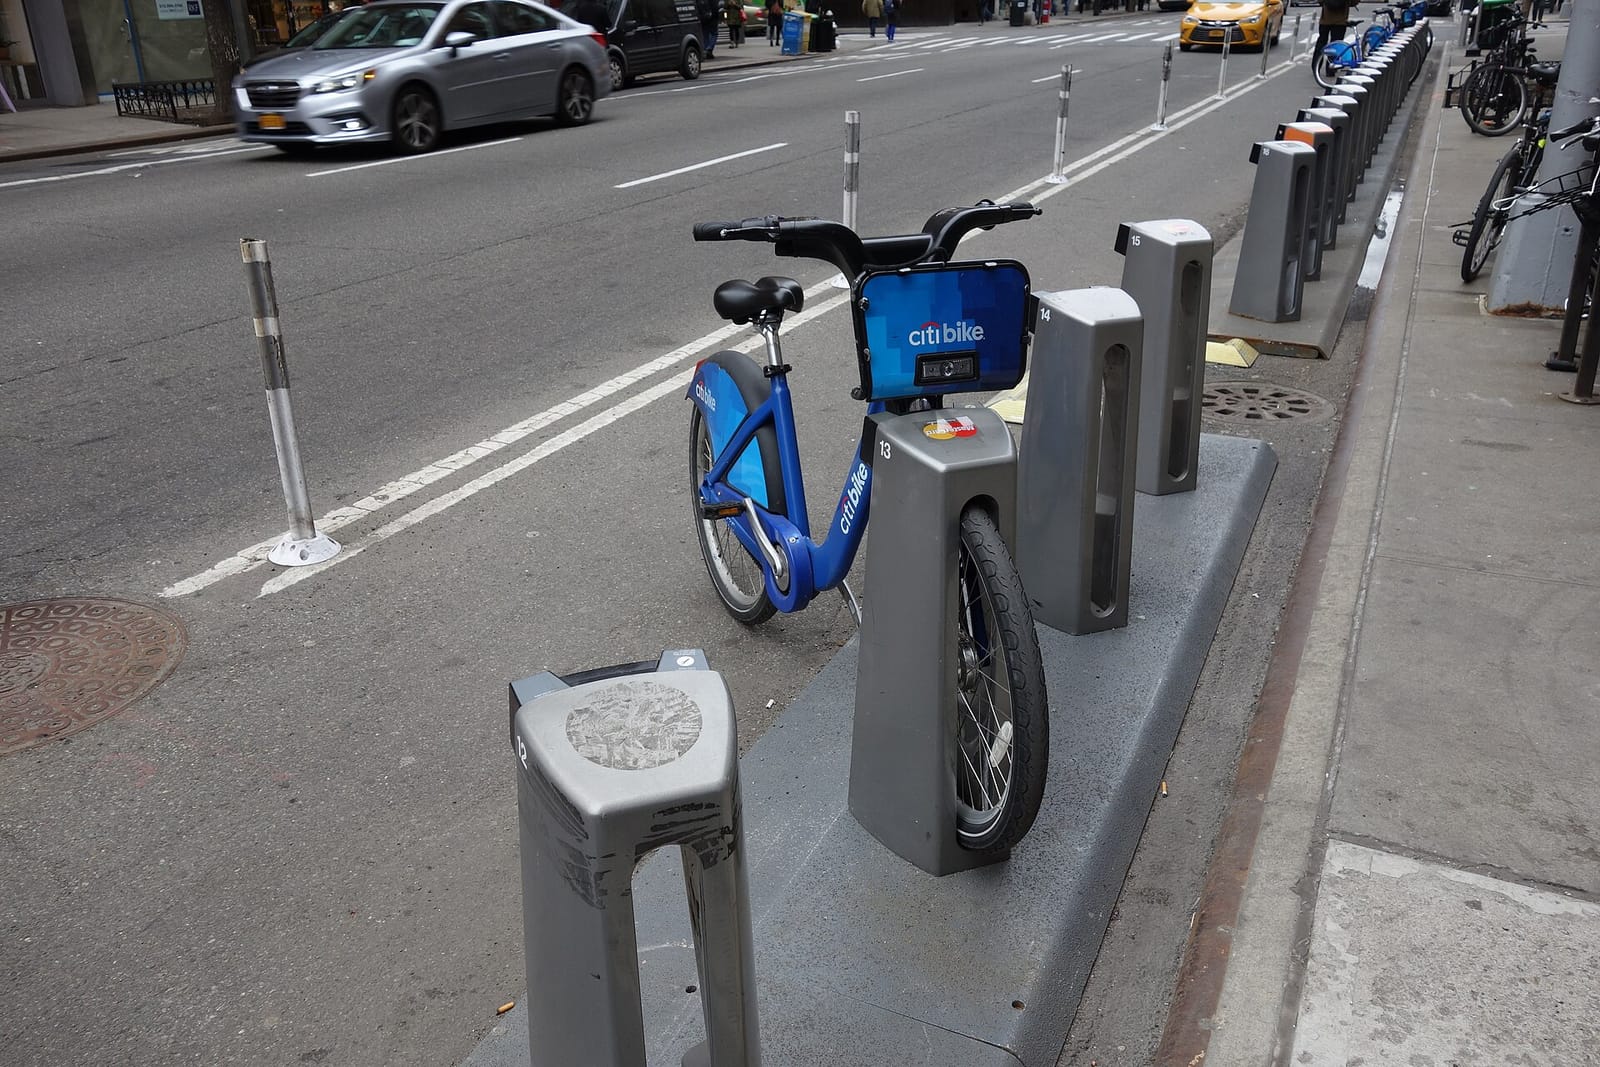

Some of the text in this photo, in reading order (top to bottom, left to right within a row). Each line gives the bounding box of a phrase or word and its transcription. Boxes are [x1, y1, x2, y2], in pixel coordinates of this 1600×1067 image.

[1131, 235, 1141, 246] 15
[1040, 307, 1051, 322] 14
[908, 321, 984, 346] citi bike
[879, 439, 891, 460] 13
[840, 463, 868, 535] citi bike
[516, 735, 528, 770] 12
